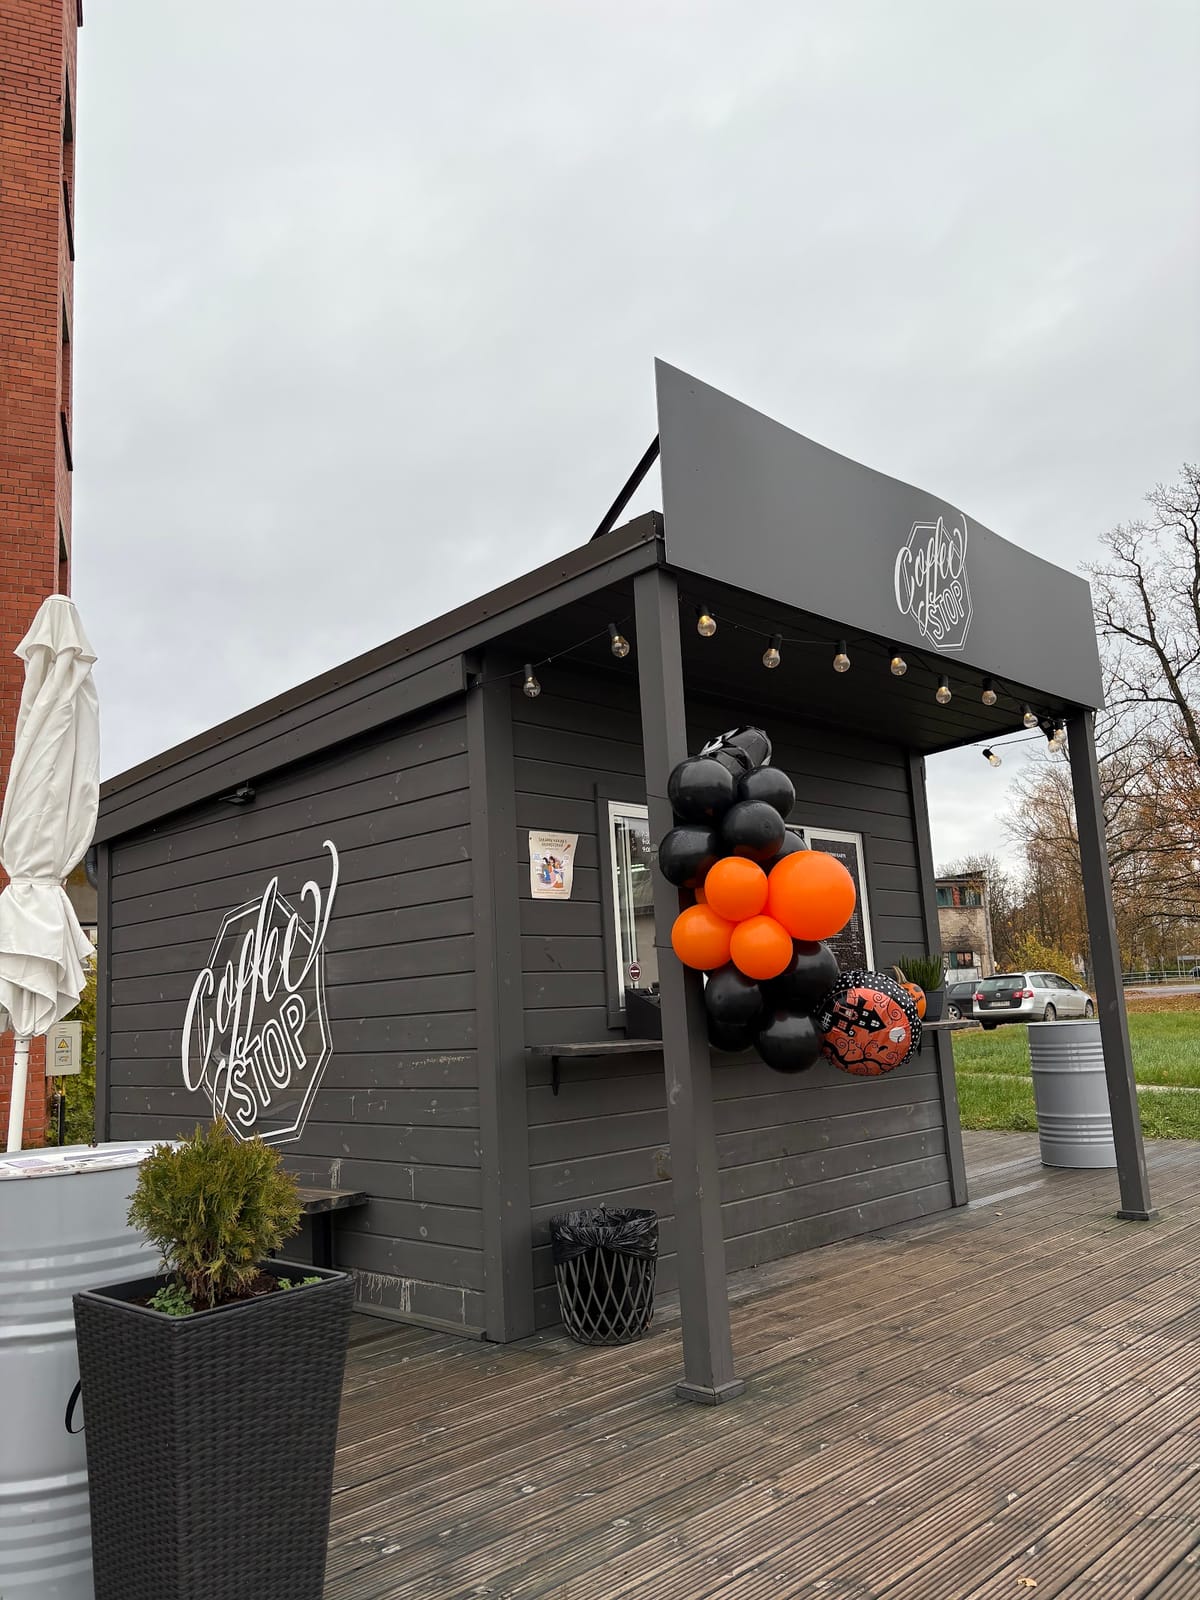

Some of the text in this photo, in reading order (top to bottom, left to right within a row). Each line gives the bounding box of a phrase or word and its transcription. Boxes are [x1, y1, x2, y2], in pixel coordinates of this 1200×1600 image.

[894, 514, 967, 636] Coffee
[928, 580, 964, 640] STOP
[181, 839, 339, 1124] Coffee
[229, 994, 307, 1126] STOP
